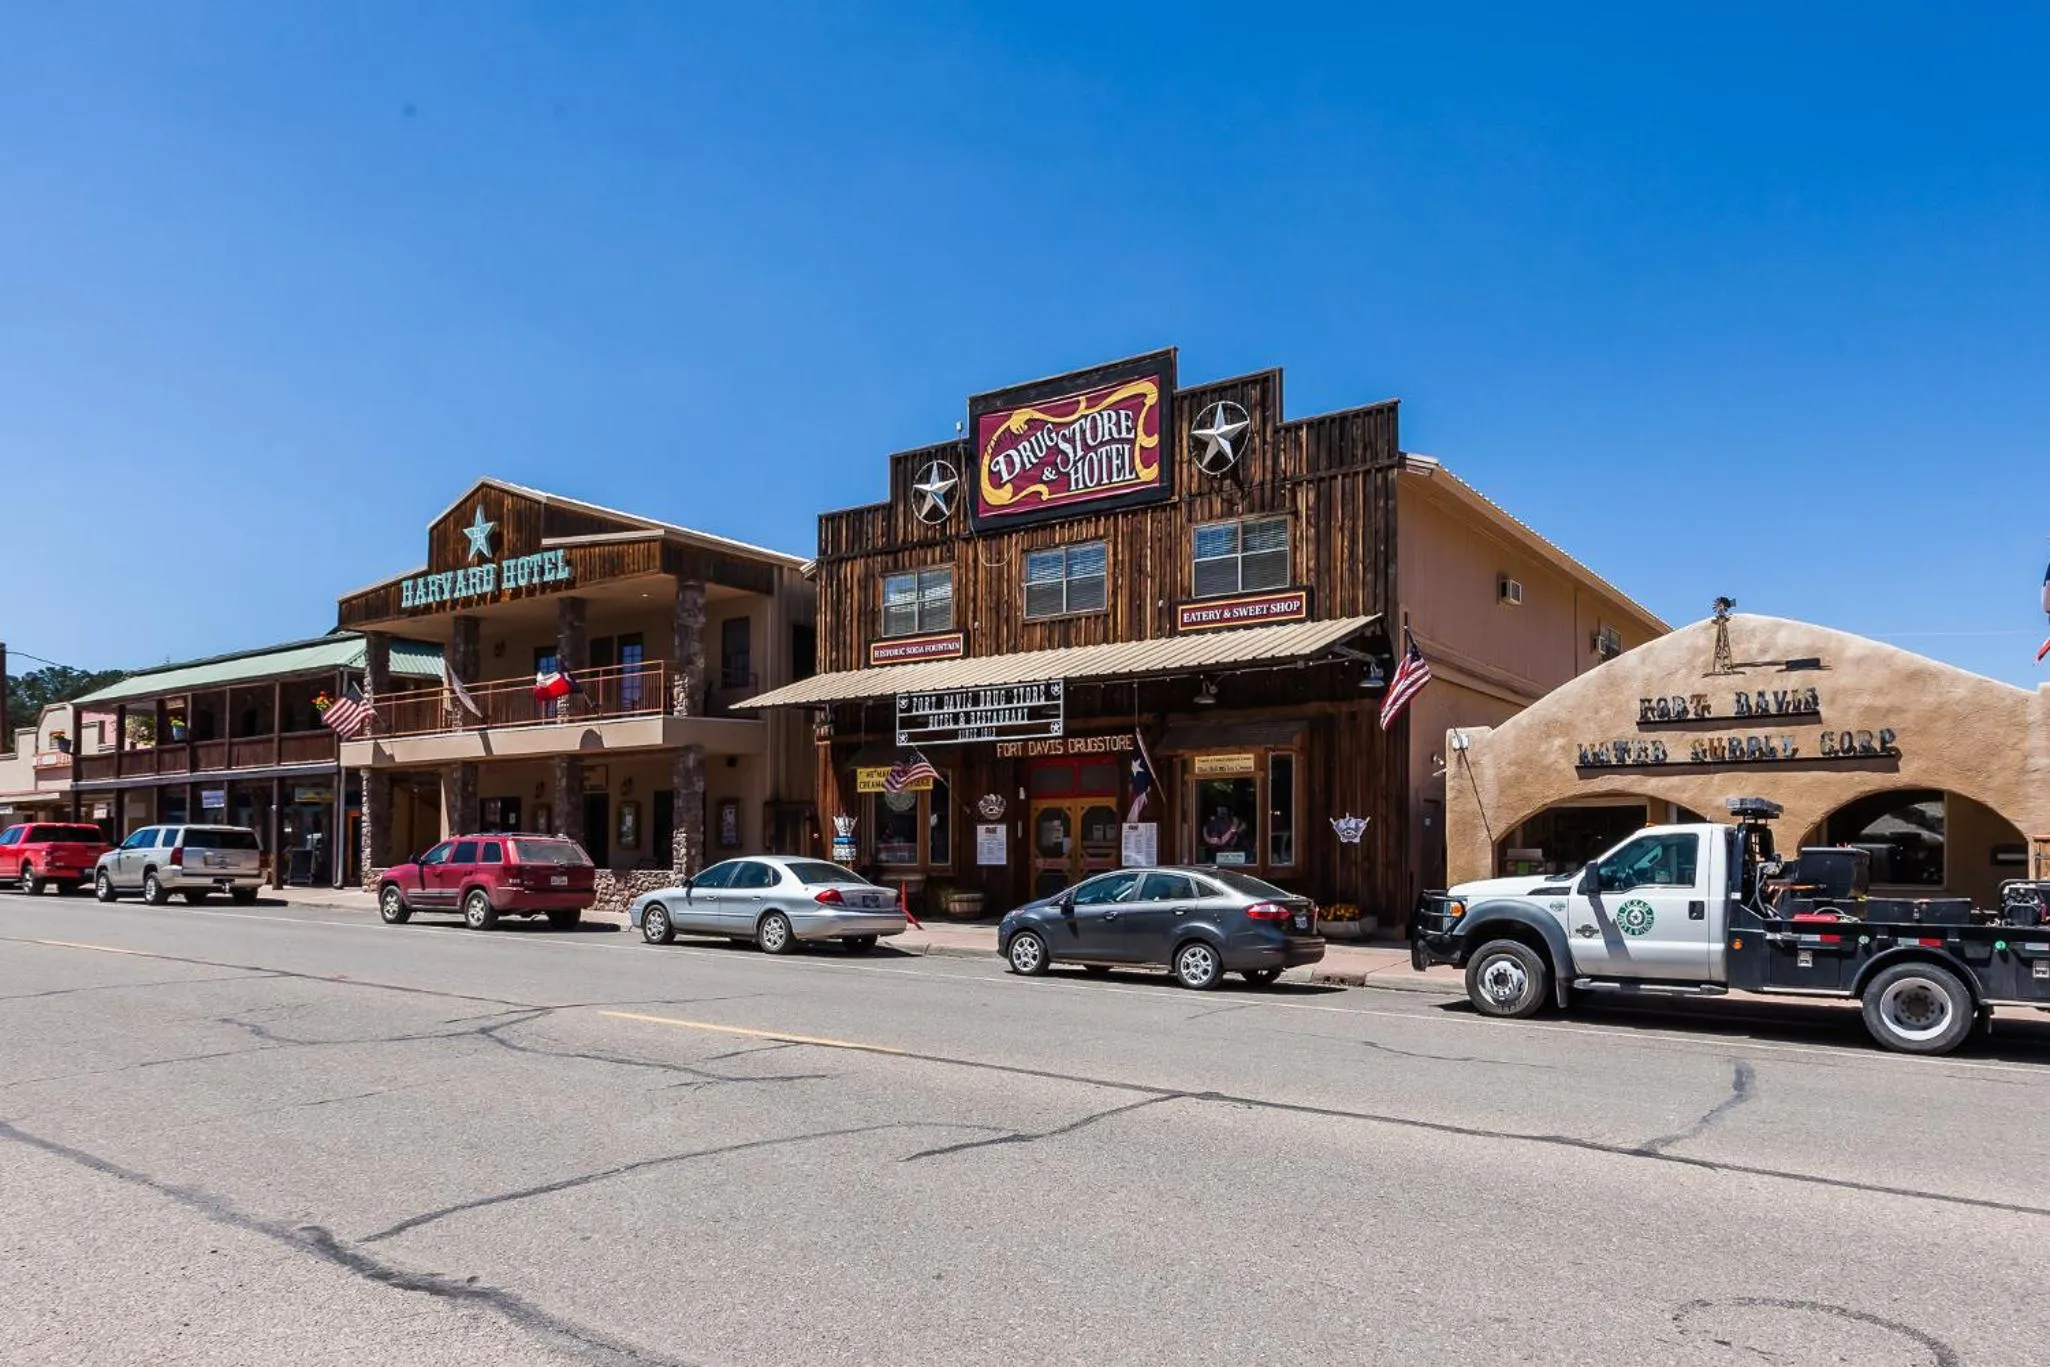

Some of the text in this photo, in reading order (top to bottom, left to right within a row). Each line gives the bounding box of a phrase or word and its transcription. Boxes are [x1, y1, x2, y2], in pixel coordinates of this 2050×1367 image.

[991, 409, 1136, 484] DRUG STORE
[1042, 443, 1137, 492] & HOTEL
[401, 549, 572, 608] HARVARD HOTEL
[1182, 600, 1301, 623] EATERY & SWEET SHOP
[874, 641, 960, 659] HISTORIC SODA FOUNTAIN
[912, 684, 1046, 714] FORT DAVIS DRUG STORE
[1639, 687, 1820, 721] FORT DAVIS
[928, 708, 1029, 729] HOTEL & RESTAURANT
[997, 734, 1134, 758] FORT DAVIS DRUGSTORE
[1577, 727, 1897, 766] WATER SUPPLY CORP
